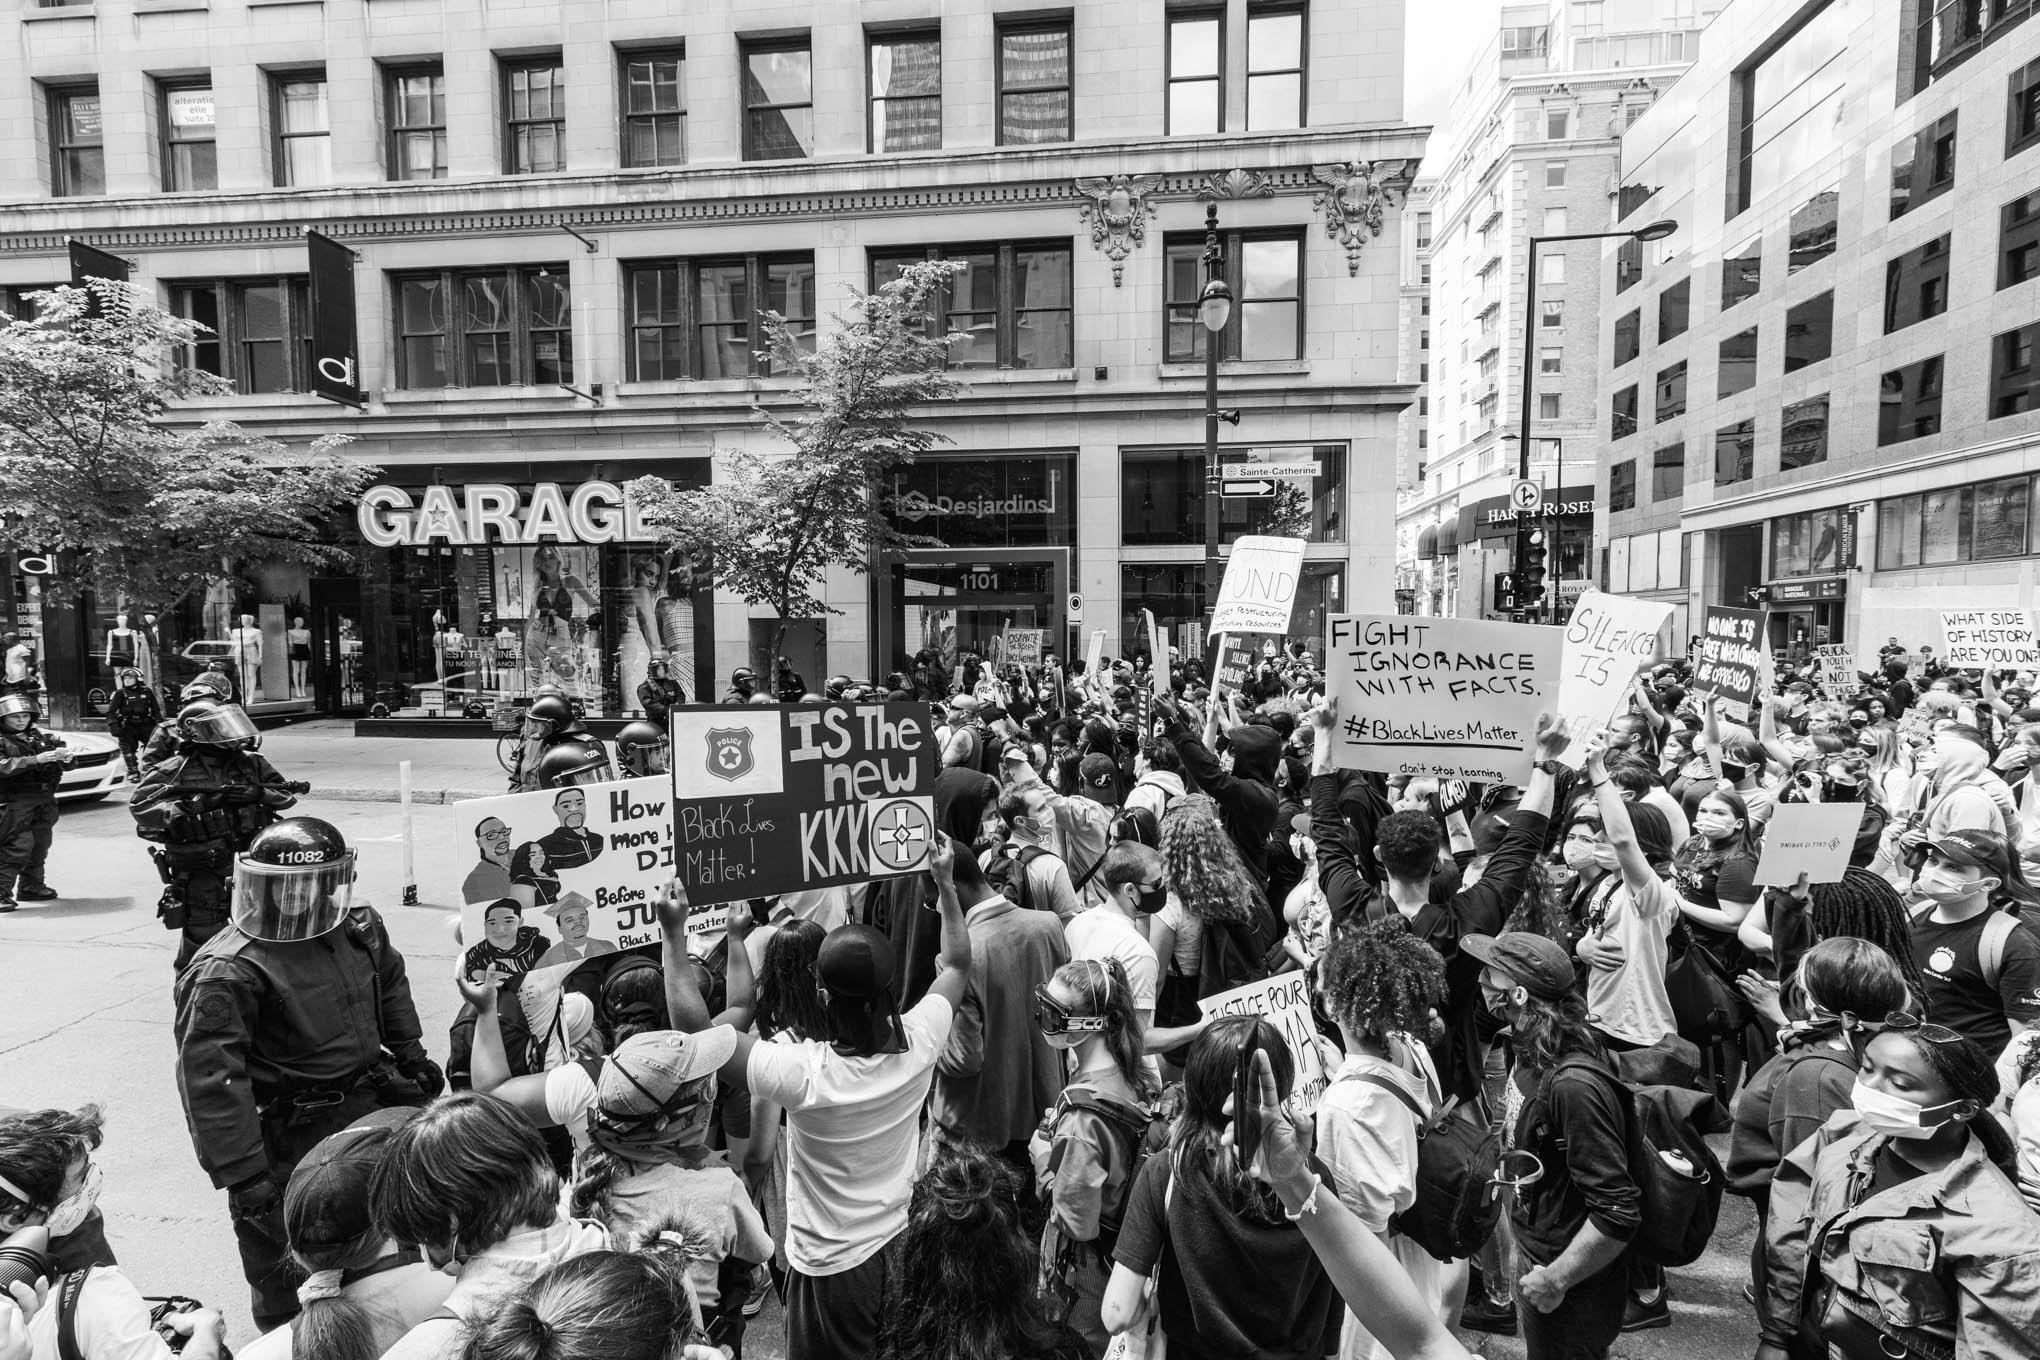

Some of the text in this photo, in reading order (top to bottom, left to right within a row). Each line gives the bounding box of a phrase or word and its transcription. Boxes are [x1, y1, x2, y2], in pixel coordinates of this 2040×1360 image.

[1240, 467, 1317, 476] Sainte-Catherine
[937, 495, 1048, 519] Desjardins
[960, 573, 999, 590] 1101
[1943, 612, 2024, 626] WHAT SIDE
[1332, 619, 1430, 649] FIGHT
[1739, 619, 1755, 642] IS
[1947, 630, 2032, 644] OF HISTORY
[1349, 651, 1535, 672] IGNORANCE
[1825, 657, 1852, 665] YOUTH
[1950, 648, 1979, 661] ARE
[1979, 648, 2012, 664] YOU
[1575, 654, 1616, 686] IS
[1829, 671, 1852, 683] NOT
[1356, 675, 1541, 701] WITH FACTS.
[716, 737, 743, 747] POLICE
[789, 704, 922, 762] IS The
[823, 756, 917, 802] new
[1399, 763, 1427, 774] don't
[1432, 765, 1455, 776] stop
[610, 789, 666, 823] How
[610, 830, 659, 851] more
[799, 803, 869, 882] KKK
[277, 850, 325, 864] 11082
[595, 885, 645, 909] Before
[688, 916, 727, 933] matter
[618, 933, 652, 950] Black
[1267, 979, 1308, 1014] POUR
